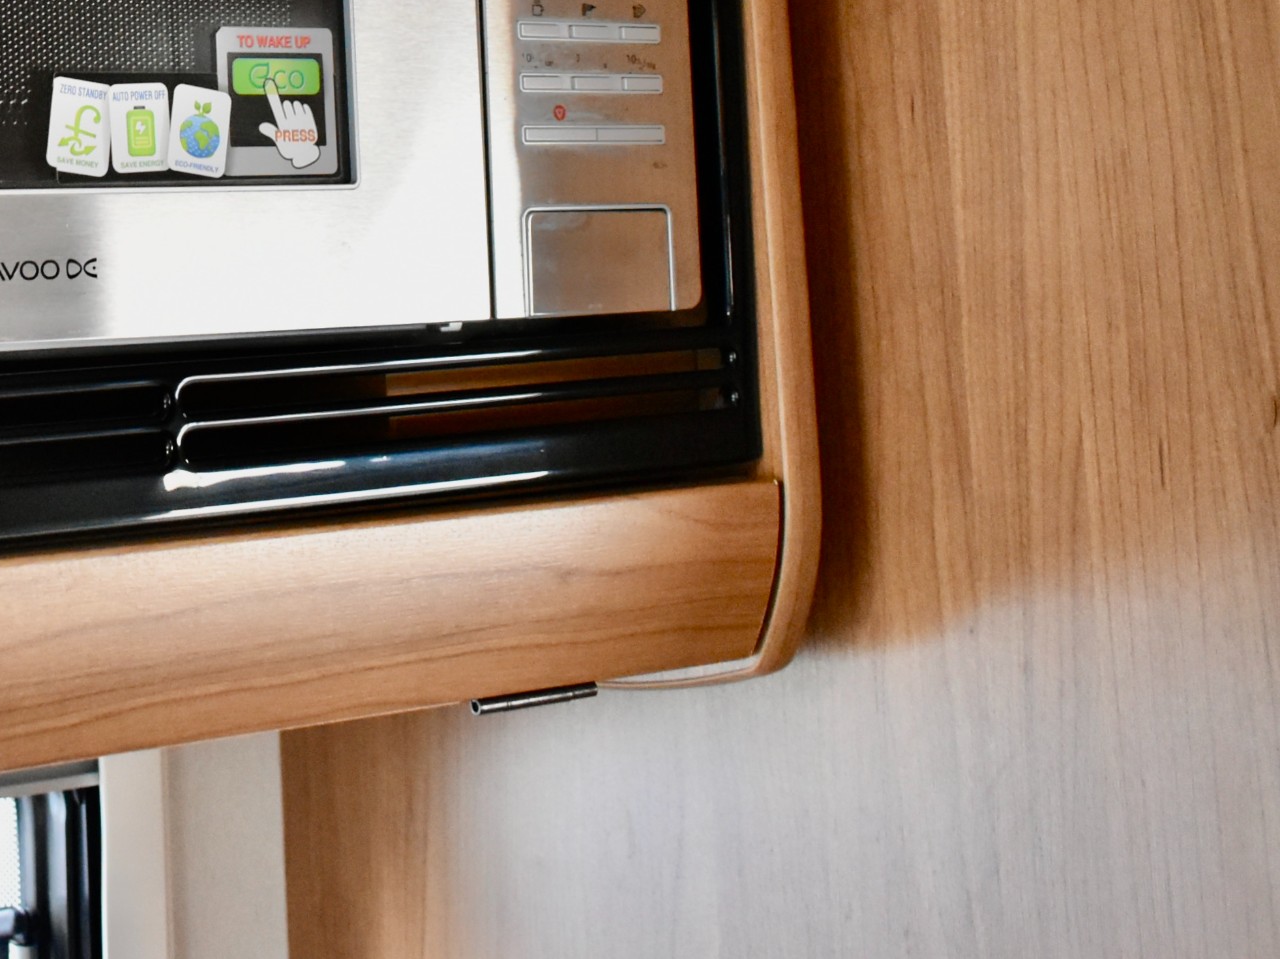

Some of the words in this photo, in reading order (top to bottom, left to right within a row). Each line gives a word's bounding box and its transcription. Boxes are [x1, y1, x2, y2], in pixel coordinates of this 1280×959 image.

[237, 35, 255, 48] TO
[256, 36, 293, 49] WAKE
[294, 36, 311, 49] UP
[60, 83, 77, 96] ZERO
[77, 87, 108, 101] STANDBY
[112, 91, 129, 102] AUTO
[130, 90, 153, 101] POWER
[154, 89, 166, 100] OFF
[275, 129, 316, 142] PRESS
[56, 156, 74, 166] SAVE
[75, 158, 99, 169] MONEY
[120, 161, 138, 169] SAVE
[138, 159, 165, 168] ENERGY
[174, 159, 220, 174] ECO-FRIENDLY
